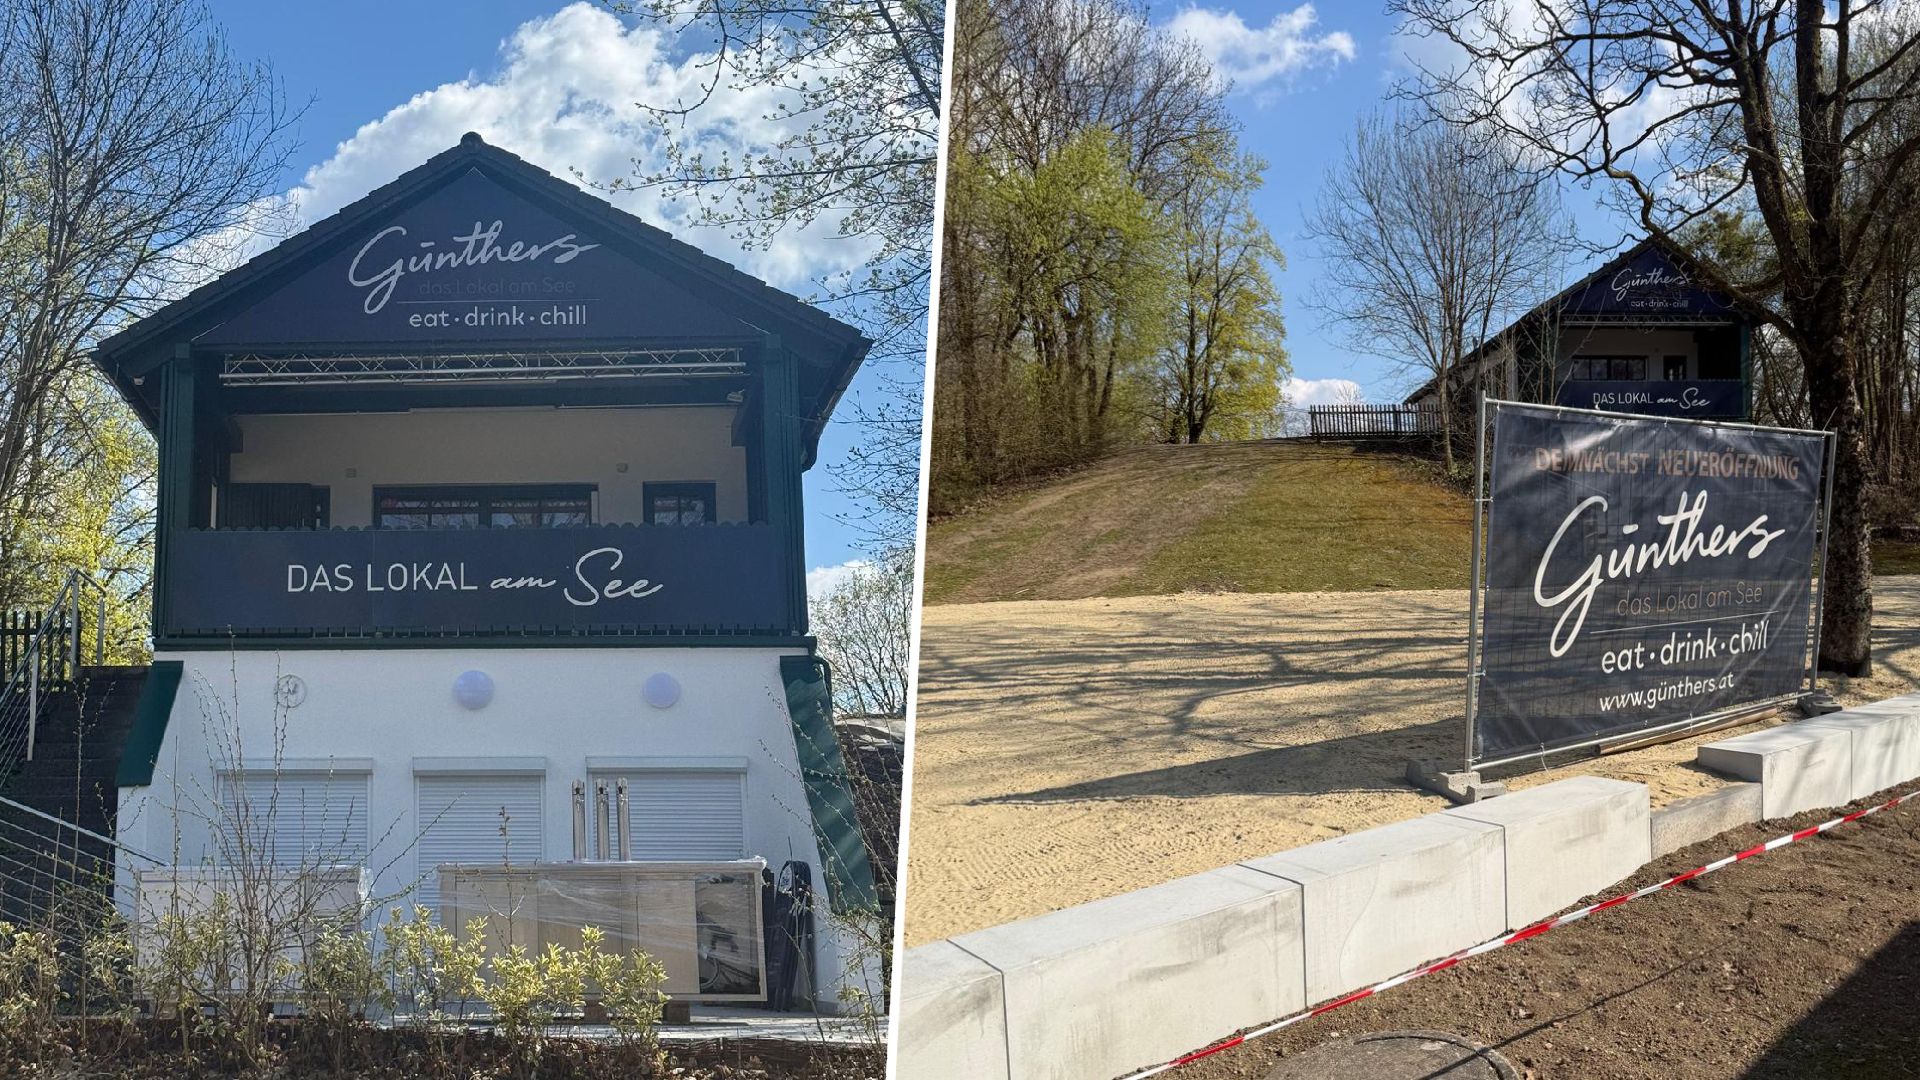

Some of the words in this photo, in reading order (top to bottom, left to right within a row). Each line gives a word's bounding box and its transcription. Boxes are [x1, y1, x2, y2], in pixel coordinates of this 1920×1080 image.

[419, 280, 452, 295] das
[456, 279, 504, 294] Lokal
[509, 281, 537, 294] am
[542, 276, 576, 293] See
[409, 310, 450, 327] eat
[464, 305, 525, 326] drink
[540, 305, 586, 325] chill
[1593, 392, 1615, 404] DAS
[1618, 392, 1654, 404] LOKAL
[1679, 387, 1710, 410] See
[1535, 446, 1650, 474] DEMNÄCHST
[1657, 447, 1801, 482] NEUERÖFFNUNG
[287, 564, 354, 593] DAS
[366, 563, 479, 593] LOKAL
[489, 576, 557, 591] am
[563, 547, 664, 606] See
[1617, 588, 1651, 617] das
[1656, 585, 1703, 614] Lokal
[1706, 588, 1732, 608] am
[1736, 580, 1763, 605] See
[1601, 641, 1645, 674] eat
[1660, 627, 1718, 666] drink
[1729, 619, 1770, 655] chill
[1599, 671, 1735, 712] www.günthers.at
